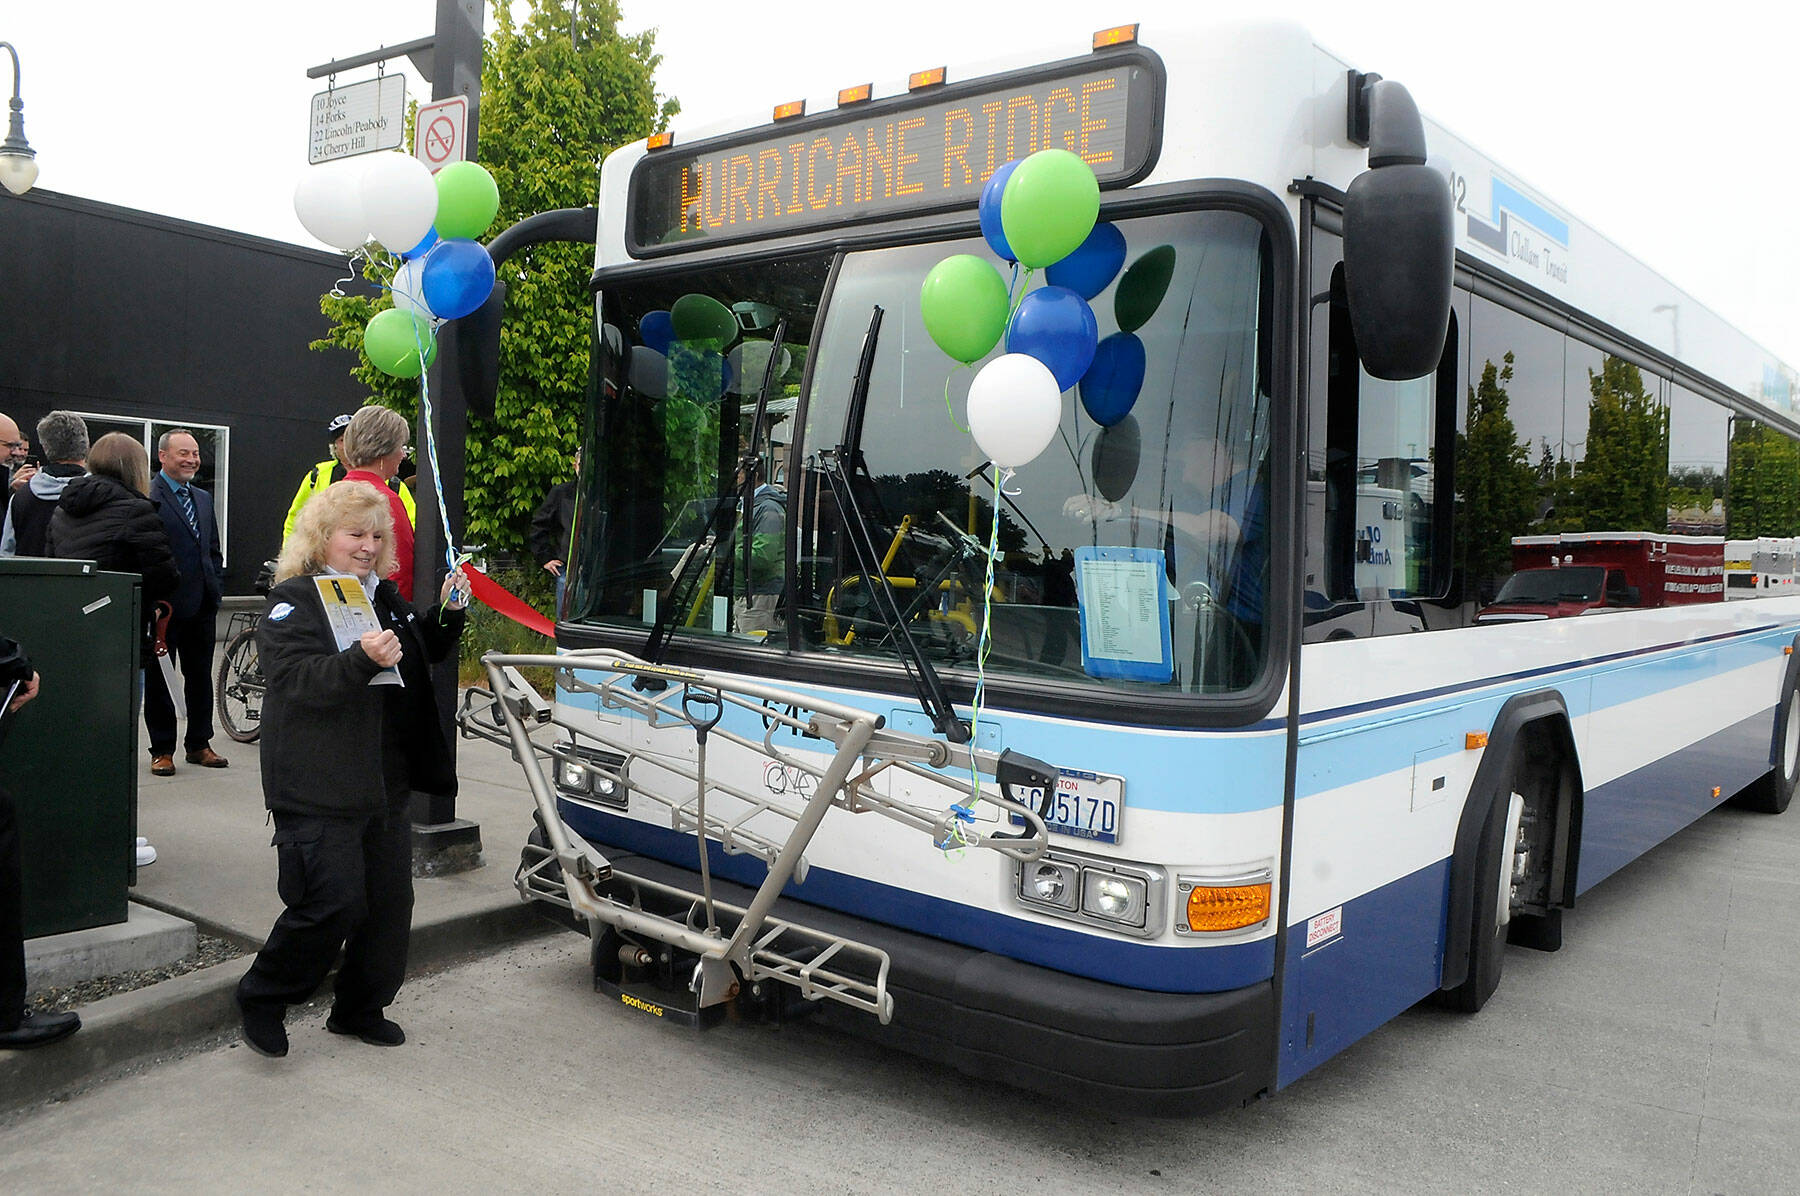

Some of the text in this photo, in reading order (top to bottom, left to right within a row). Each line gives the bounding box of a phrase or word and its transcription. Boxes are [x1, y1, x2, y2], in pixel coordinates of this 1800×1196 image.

[317, 96, 347, 111] 10 Joyce
[314, 116, 388, 143] 22 Lincoln/Peabody
[316, 110, 346, 126] 14 Forks
[314, 136, 366, 158] 24 Cherry Hill
[681, 77, 1115, 232] HURRICANE RIDGE
[1511, 230, 1568, 284] Clallam Transit
[1057, 780, 1078, 791] TON
[1073, 827, 1093, 839] USA
[1308, 913, 1339, 942] BATTERY DISCONNECT
[621, 993, 663, 1017] sportworks
